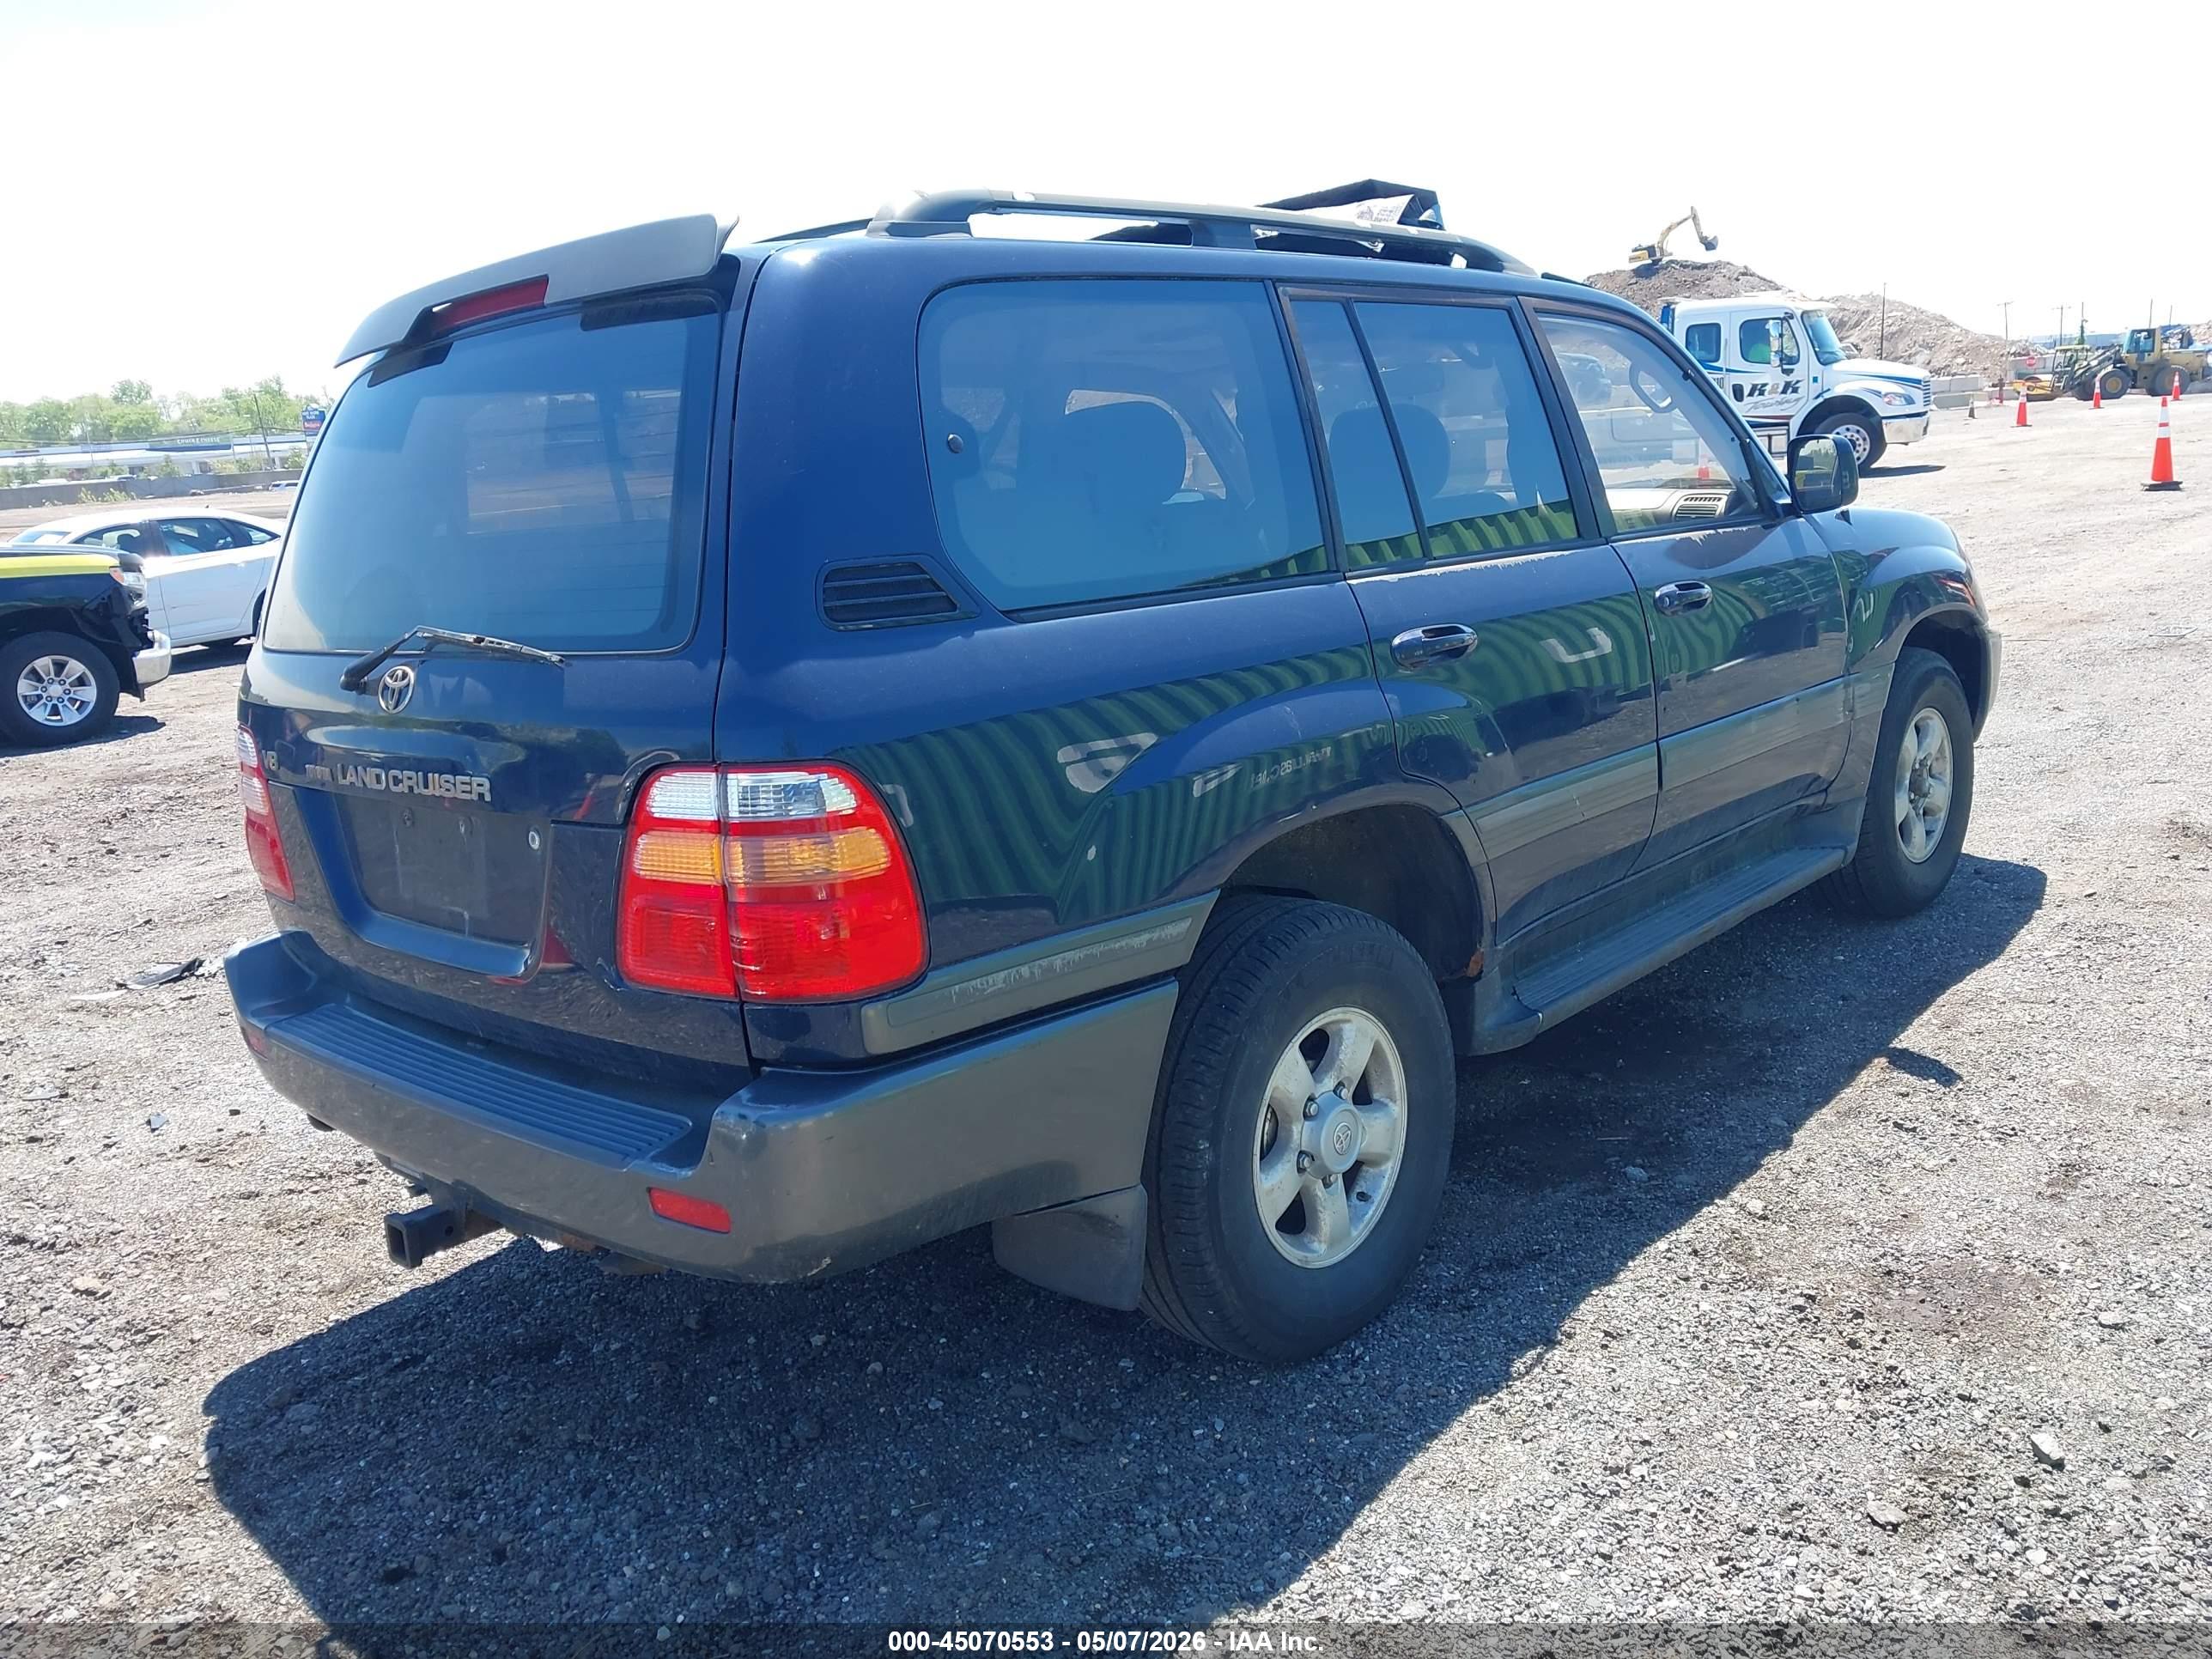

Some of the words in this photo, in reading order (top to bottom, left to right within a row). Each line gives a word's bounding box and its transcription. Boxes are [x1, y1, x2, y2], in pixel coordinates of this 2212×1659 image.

[263, 750, 279, 771] V8
[337, 763, 386, 791] LAND
[389, 769, 492, 802] CRUISER
